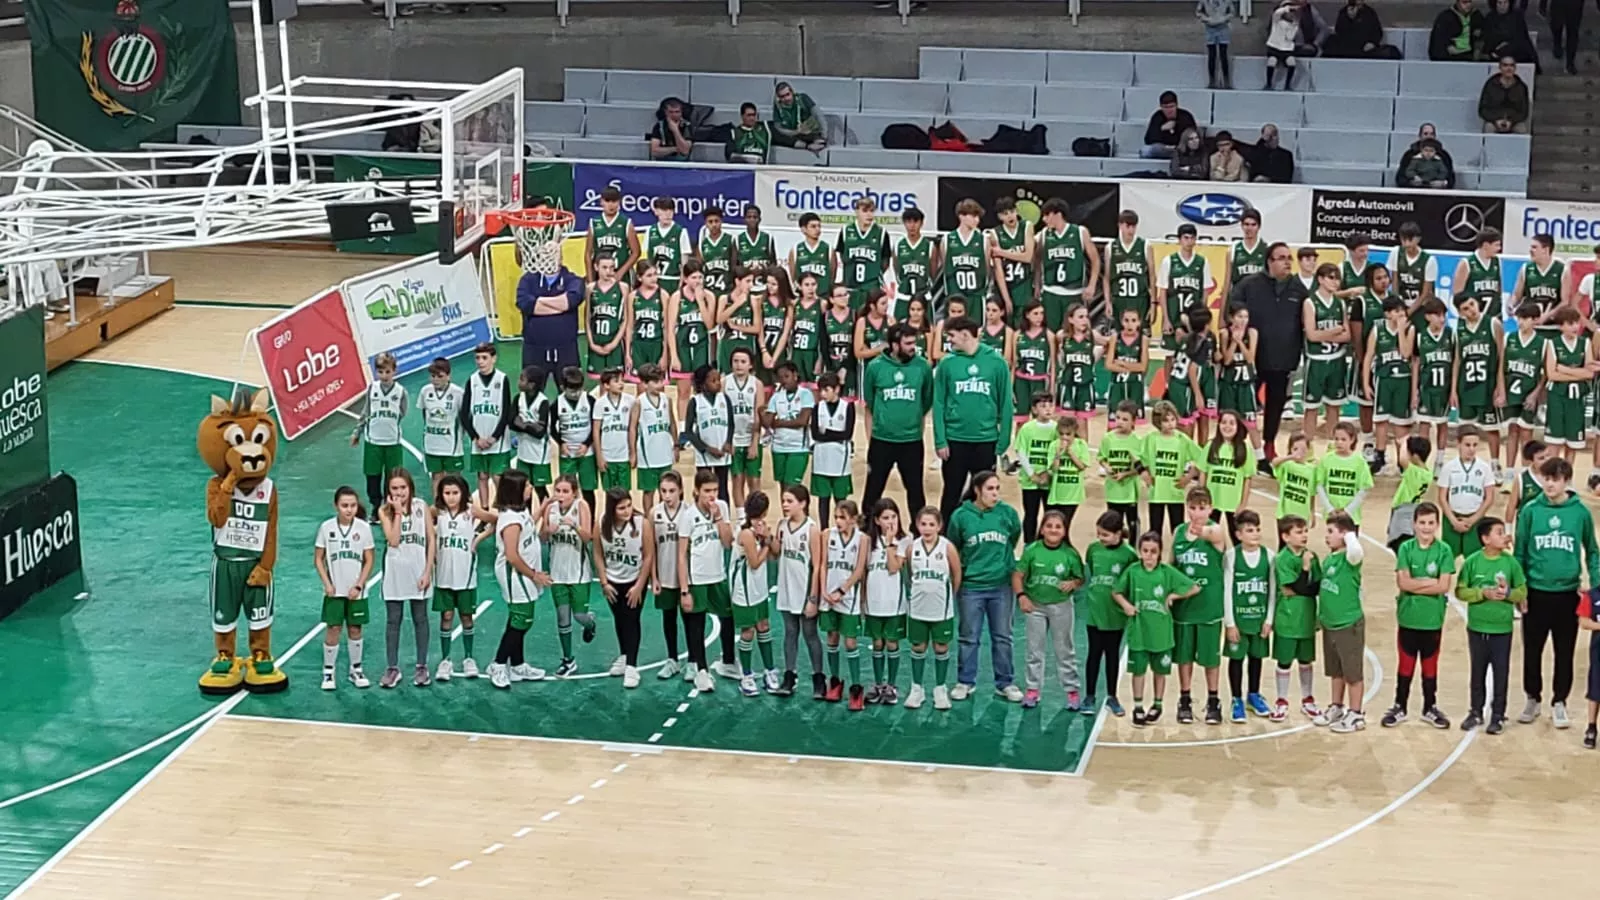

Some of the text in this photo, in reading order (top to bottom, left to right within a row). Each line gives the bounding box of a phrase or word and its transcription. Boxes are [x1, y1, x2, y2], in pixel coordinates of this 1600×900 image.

[815, 174, 868, 184] MANANTIAL
[1317, 195, 1414, 212] Ágreda Automóvil
[1316, 212, 1391, 226] Concesionario
[856, 263, 866, 282] 8
[956, 271, 977, 290] 00
[1005, 262, 1025, 281] 34
[1056, 264, 1066, 283] 6
[705, 274, 726, 292] 24
[909, 279, 917, 295] 1
[1118, 278, 1139, 296] 30
[1481, 297, 1493, 318] 7
[595, 320, 611, 336] 10
[637, 322, 656, 339] 48
[689, 327, 698, 345] 6
[793, 333, 809, 350] 38
[282, 343, 341, 393] Lobe
[1073, 367, 1082, 383] 2
[1431, 367, 1445, 387] 11
[1466, 361, 1487, 381] 25
[883, 383, 917, 401] PEÑAS
[955, 376, 991, 396] PEÑAS
[1510, 379, 1522, 394] 4
[473, 402, 500, 417] PEÑAS
[4, 508, 75, 585] Huesca
[439, 533, 469, 552] PEÑAS
[1535, 529, 1575, 553] PEÑAS
[605, 549, 639, 567] PEÑAS
